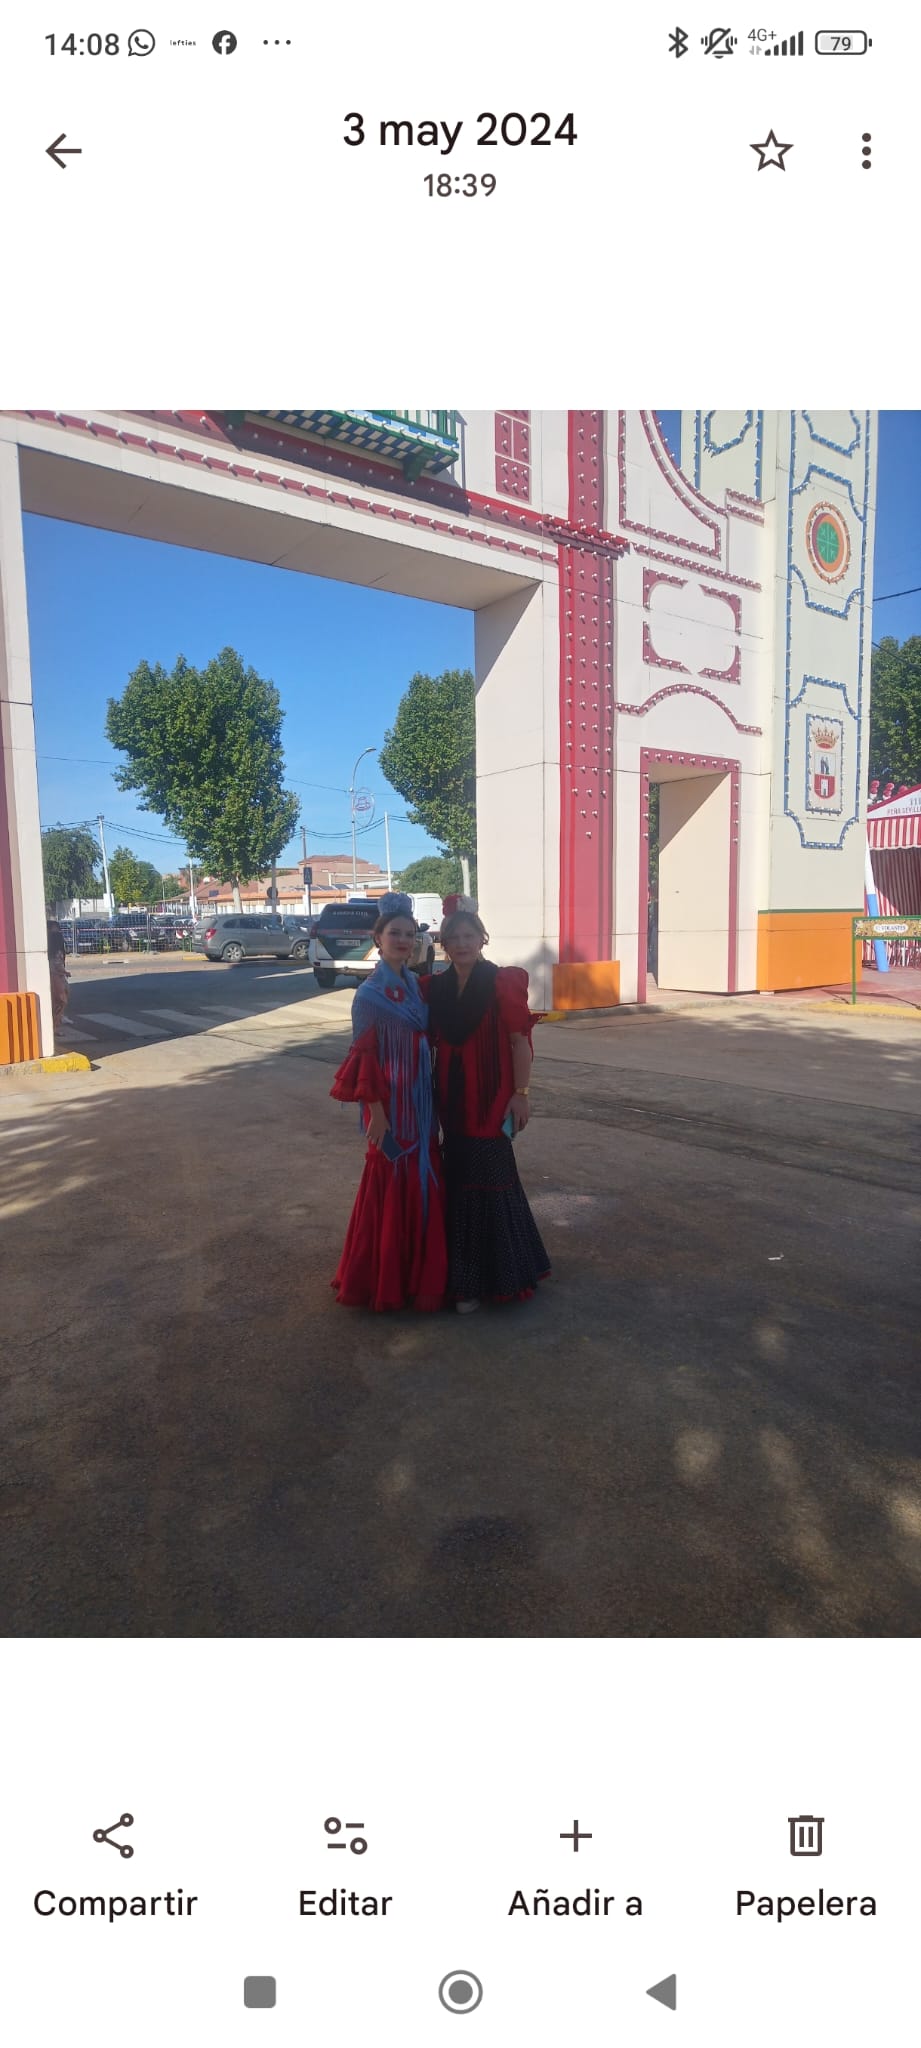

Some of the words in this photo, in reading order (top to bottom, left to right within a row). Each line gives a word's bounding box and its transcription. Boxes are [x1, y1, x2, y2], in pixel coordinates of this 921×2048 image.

[44, 33, 120, 56] 14:08
[747, 28, 777, 42] 4G+
[830, 36, 852, 52] 79
[343, 112, 365, 147] 3
[380, 120, 464, 156] may
[476, 112, 578, 147] 2024
[423, 173, 497, 198] 18:39
[33, 1888, 199, 1924] Compartir
[299, 1887, 393, 1917] Editar
[507, 1887, 615, 1917] Añadir
[625, 1896, 643, 1917] a
[736, 1887, 877, 1924] Papelera
